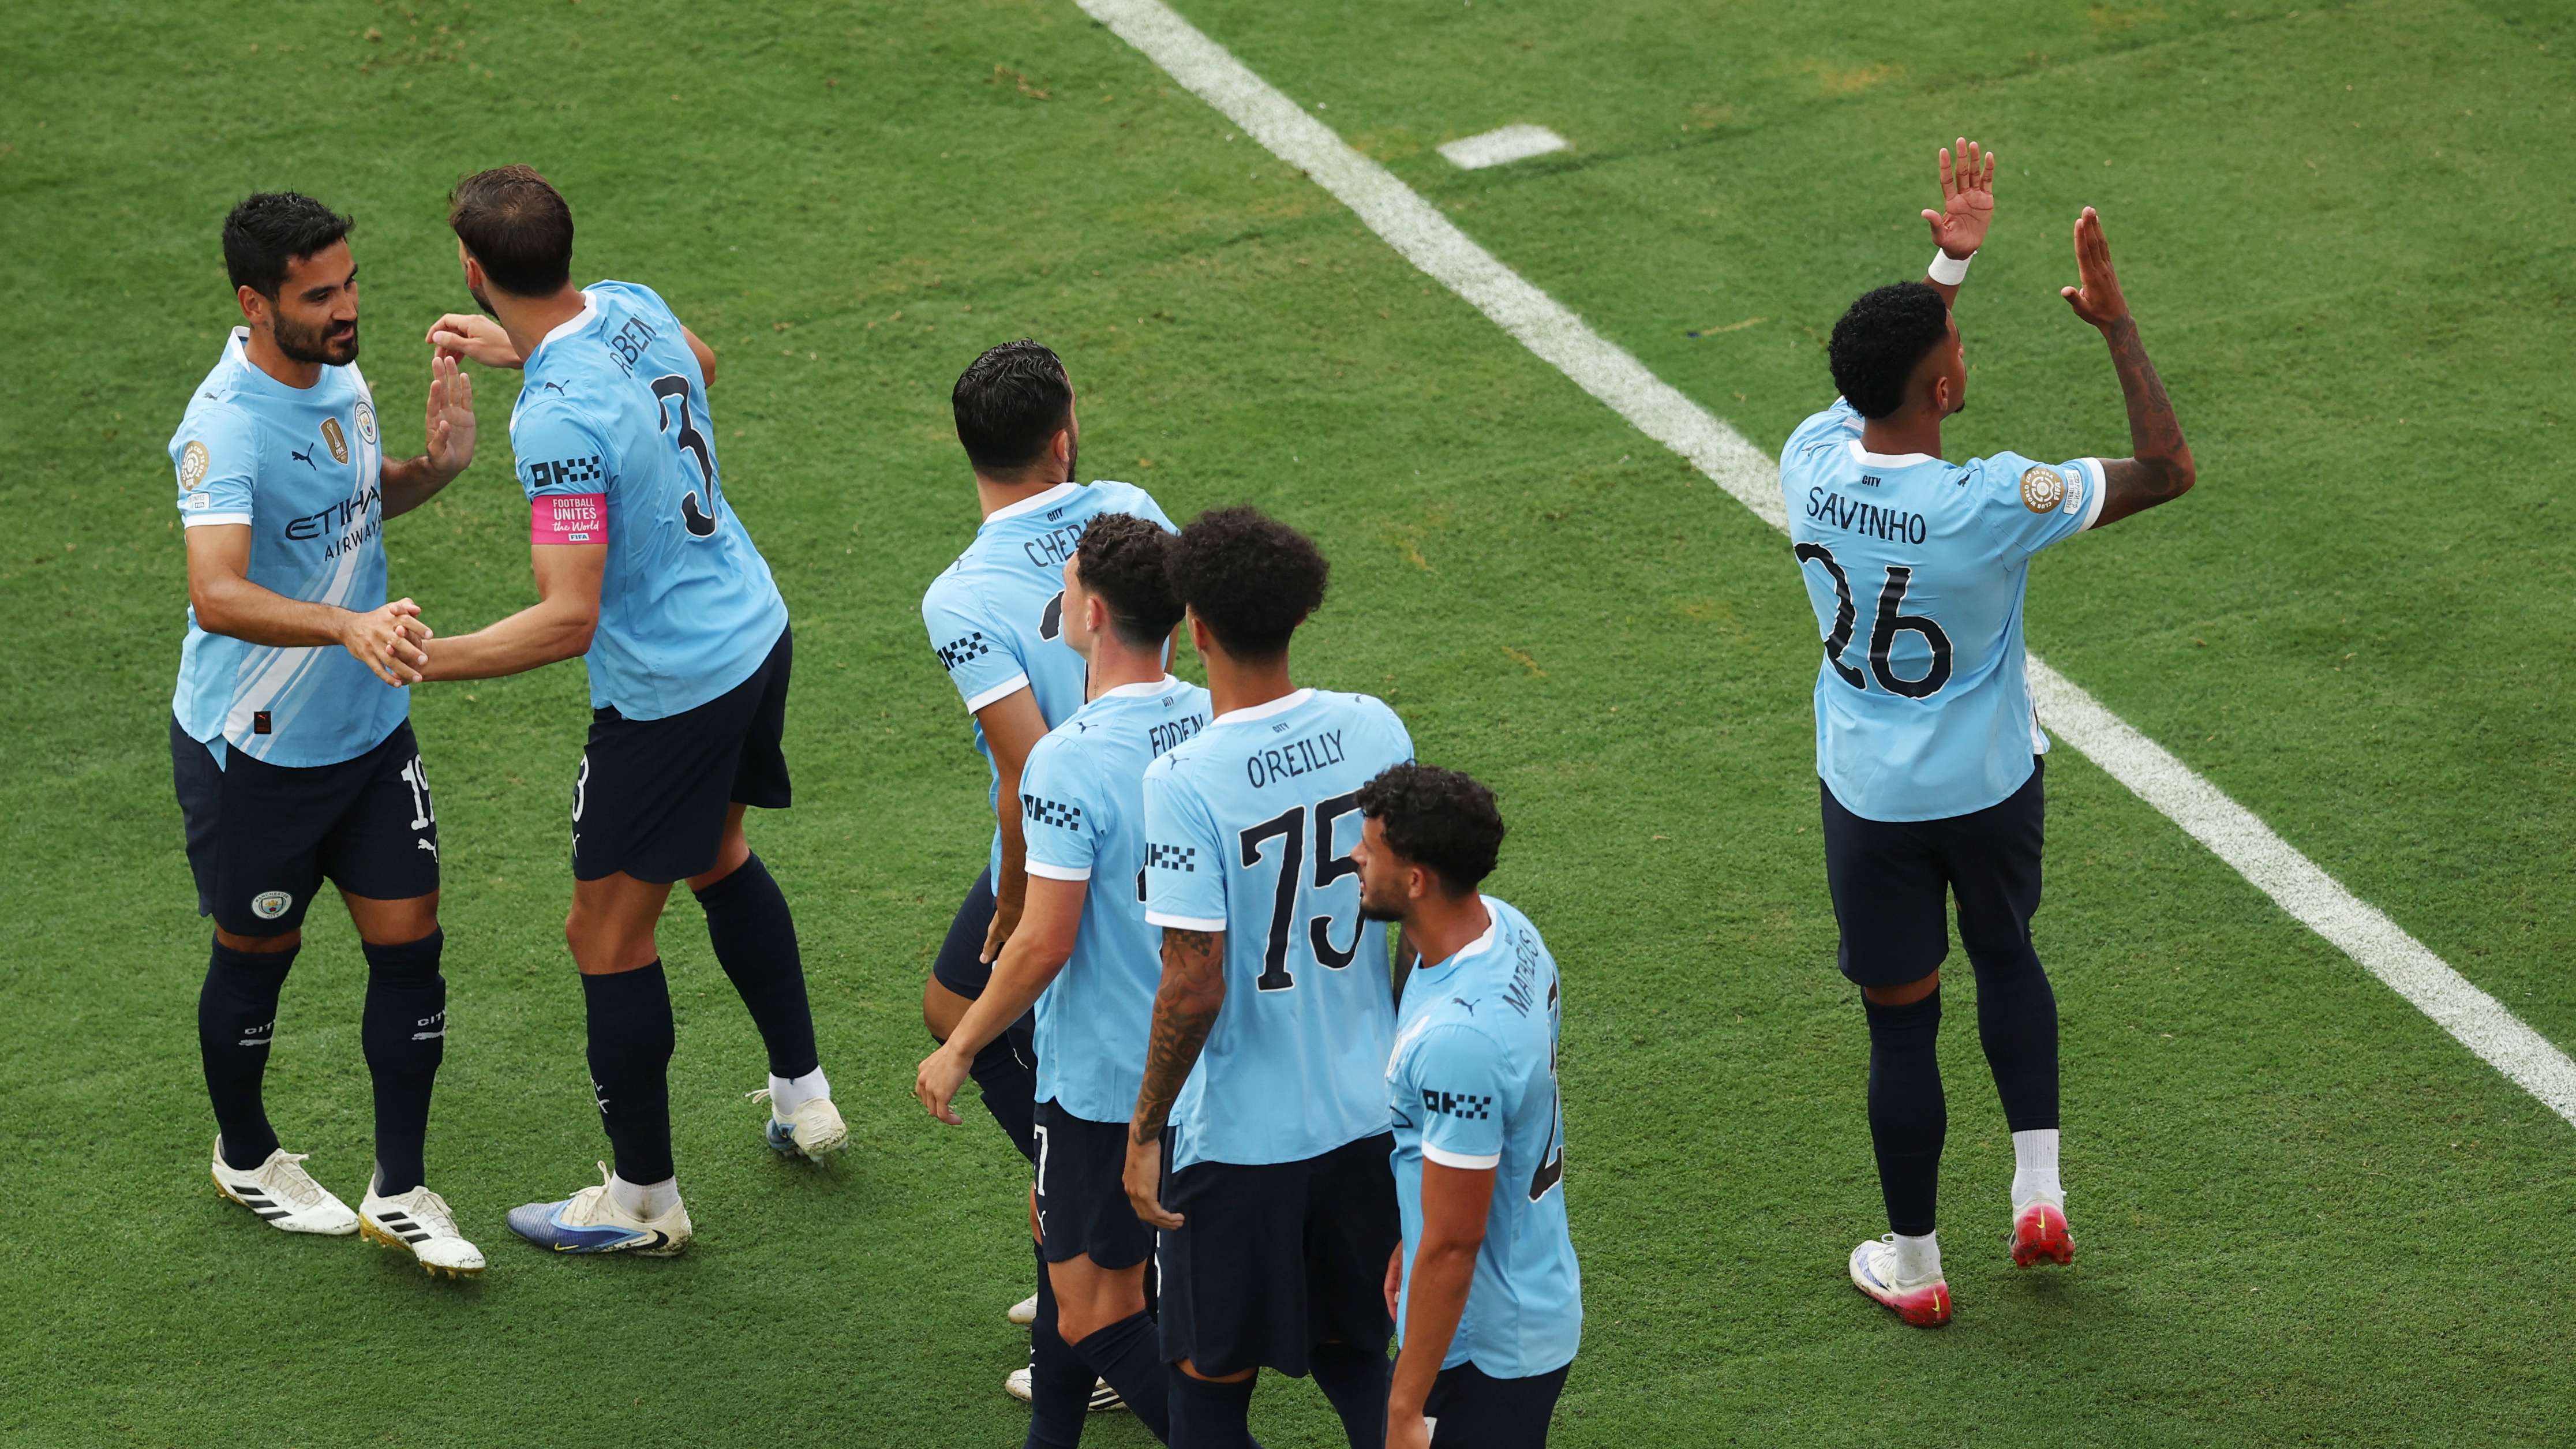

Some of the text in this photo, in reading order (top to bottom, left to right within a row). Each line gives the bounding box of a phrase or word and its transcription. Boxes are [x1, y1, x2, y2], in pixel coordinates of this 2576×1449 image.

[605, 313, 657, 379] RBEN
[193, 445, 203, 454] CUP
[336, 447, 345, 456] FIFA
[650, 374, 716, 537] 3
[196, 465, 204, 478] USA
[531, 455, 600, 488] OKX
[1862, 475, 1881, 488] CITY
[2024, 485, 2037, 507] WORLD
[2041, 470, 2054, 480] USA
[553, 497, 595, 508] FOOTBALL
[2053, 481, 2061, 501] FIFA
[552, 520, 600, 532] the World
[553, 507, 597, 521] UNITES
[1047, 507, 1064, 522] CITY
[1807, 486, 1926, 545] SAVINHO
[1024, 519, 1088, 567] CHER
[1793, 542, 1953, 700] 26
[1147, 713, 1203, 759] FODEN
[1272, 722, 1290, 733] CITY
[1247, 729, 1345, 789] O'REILLY
[401, 754, 435, 830] 19
[572, 754, 589, 822] 3
[1145, 842, 1195, 872] KX
[1239, 787, 1368, 993] 75
[1034, 1123, 1049, 1196] 7
